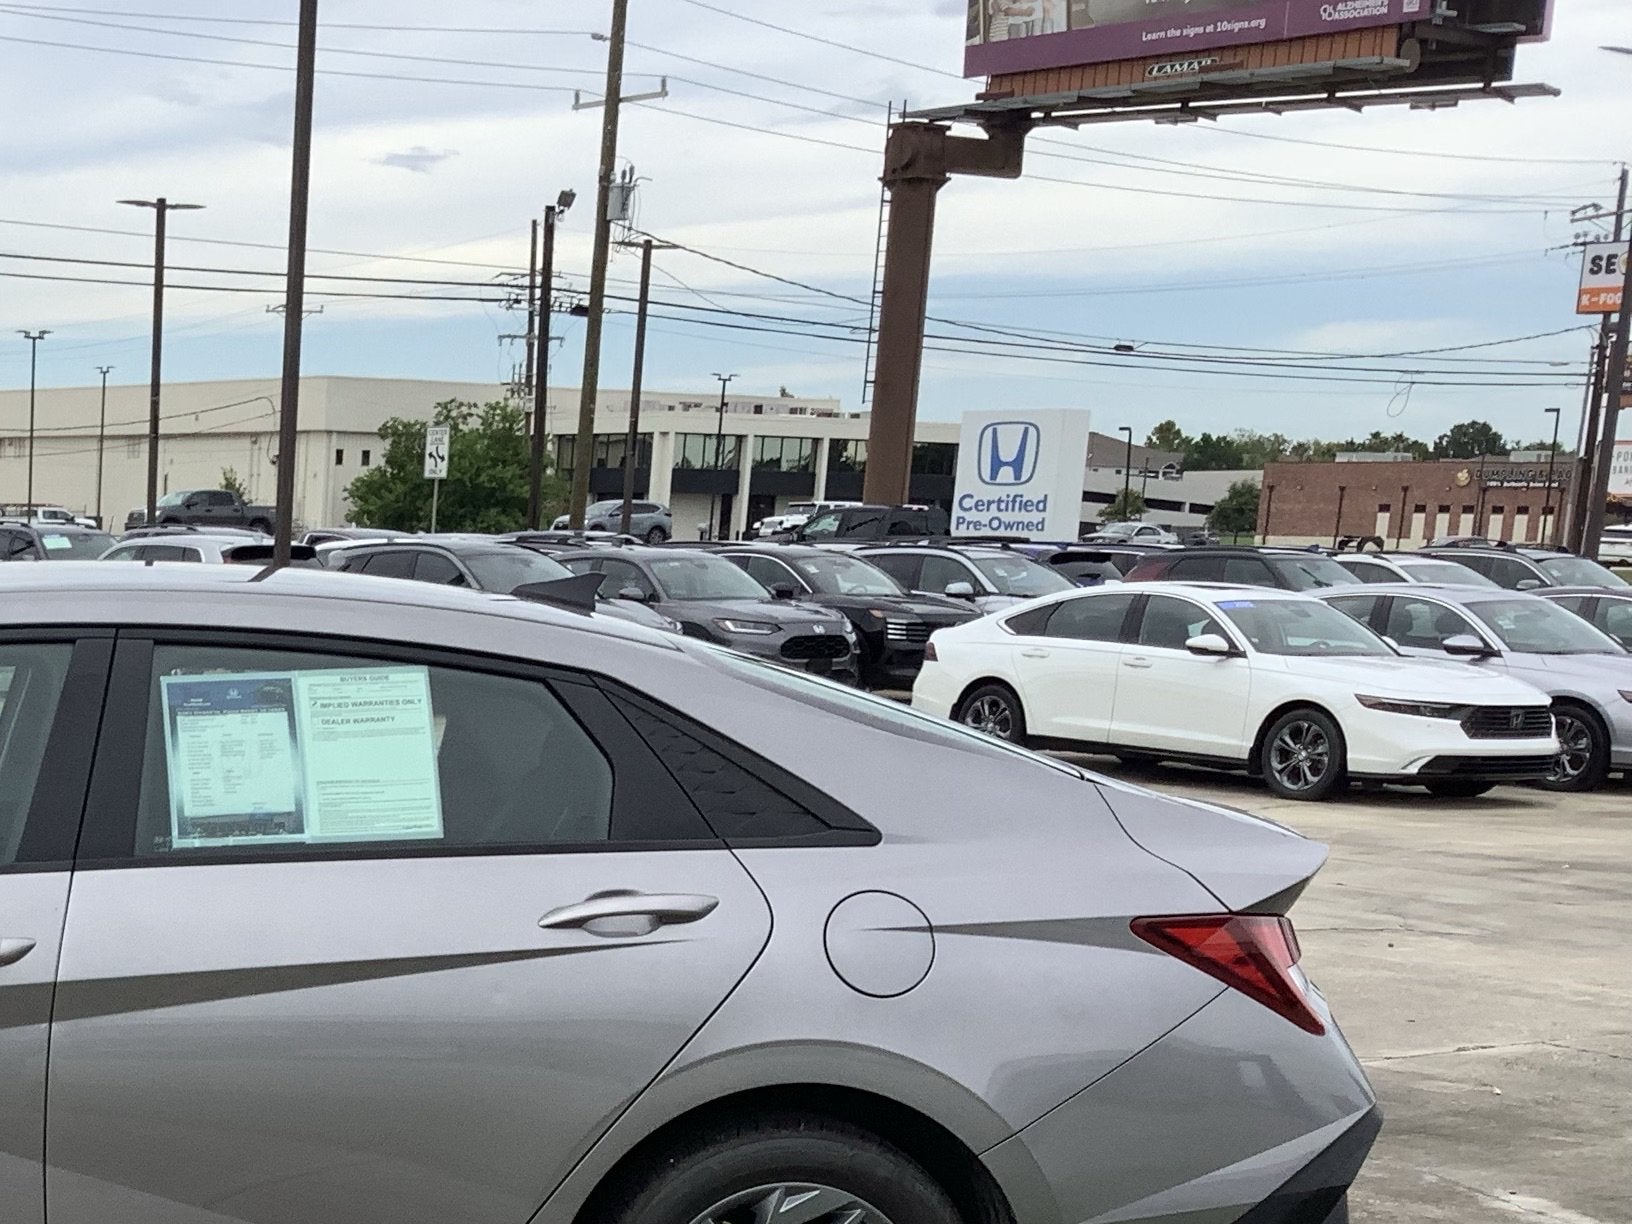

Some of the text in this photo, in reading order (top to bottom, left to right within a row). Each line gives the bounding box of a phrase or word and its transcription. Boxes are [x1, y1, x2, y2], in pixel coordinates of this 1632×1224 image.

[1334, 6, 1388, 19] ASSOCIATION
[1142, 19, 1266, 41] Learn the signs at 10signs.org
[958, 493, 1048, 513] Certified
[955, 516, 1045, 532] Pre-Owned
[320, 701, 349, 709] IMPLIED
[351, 699, 400, 708] WARRANTIES
[321, 716, 395, 726] DEALER WARRANTY
